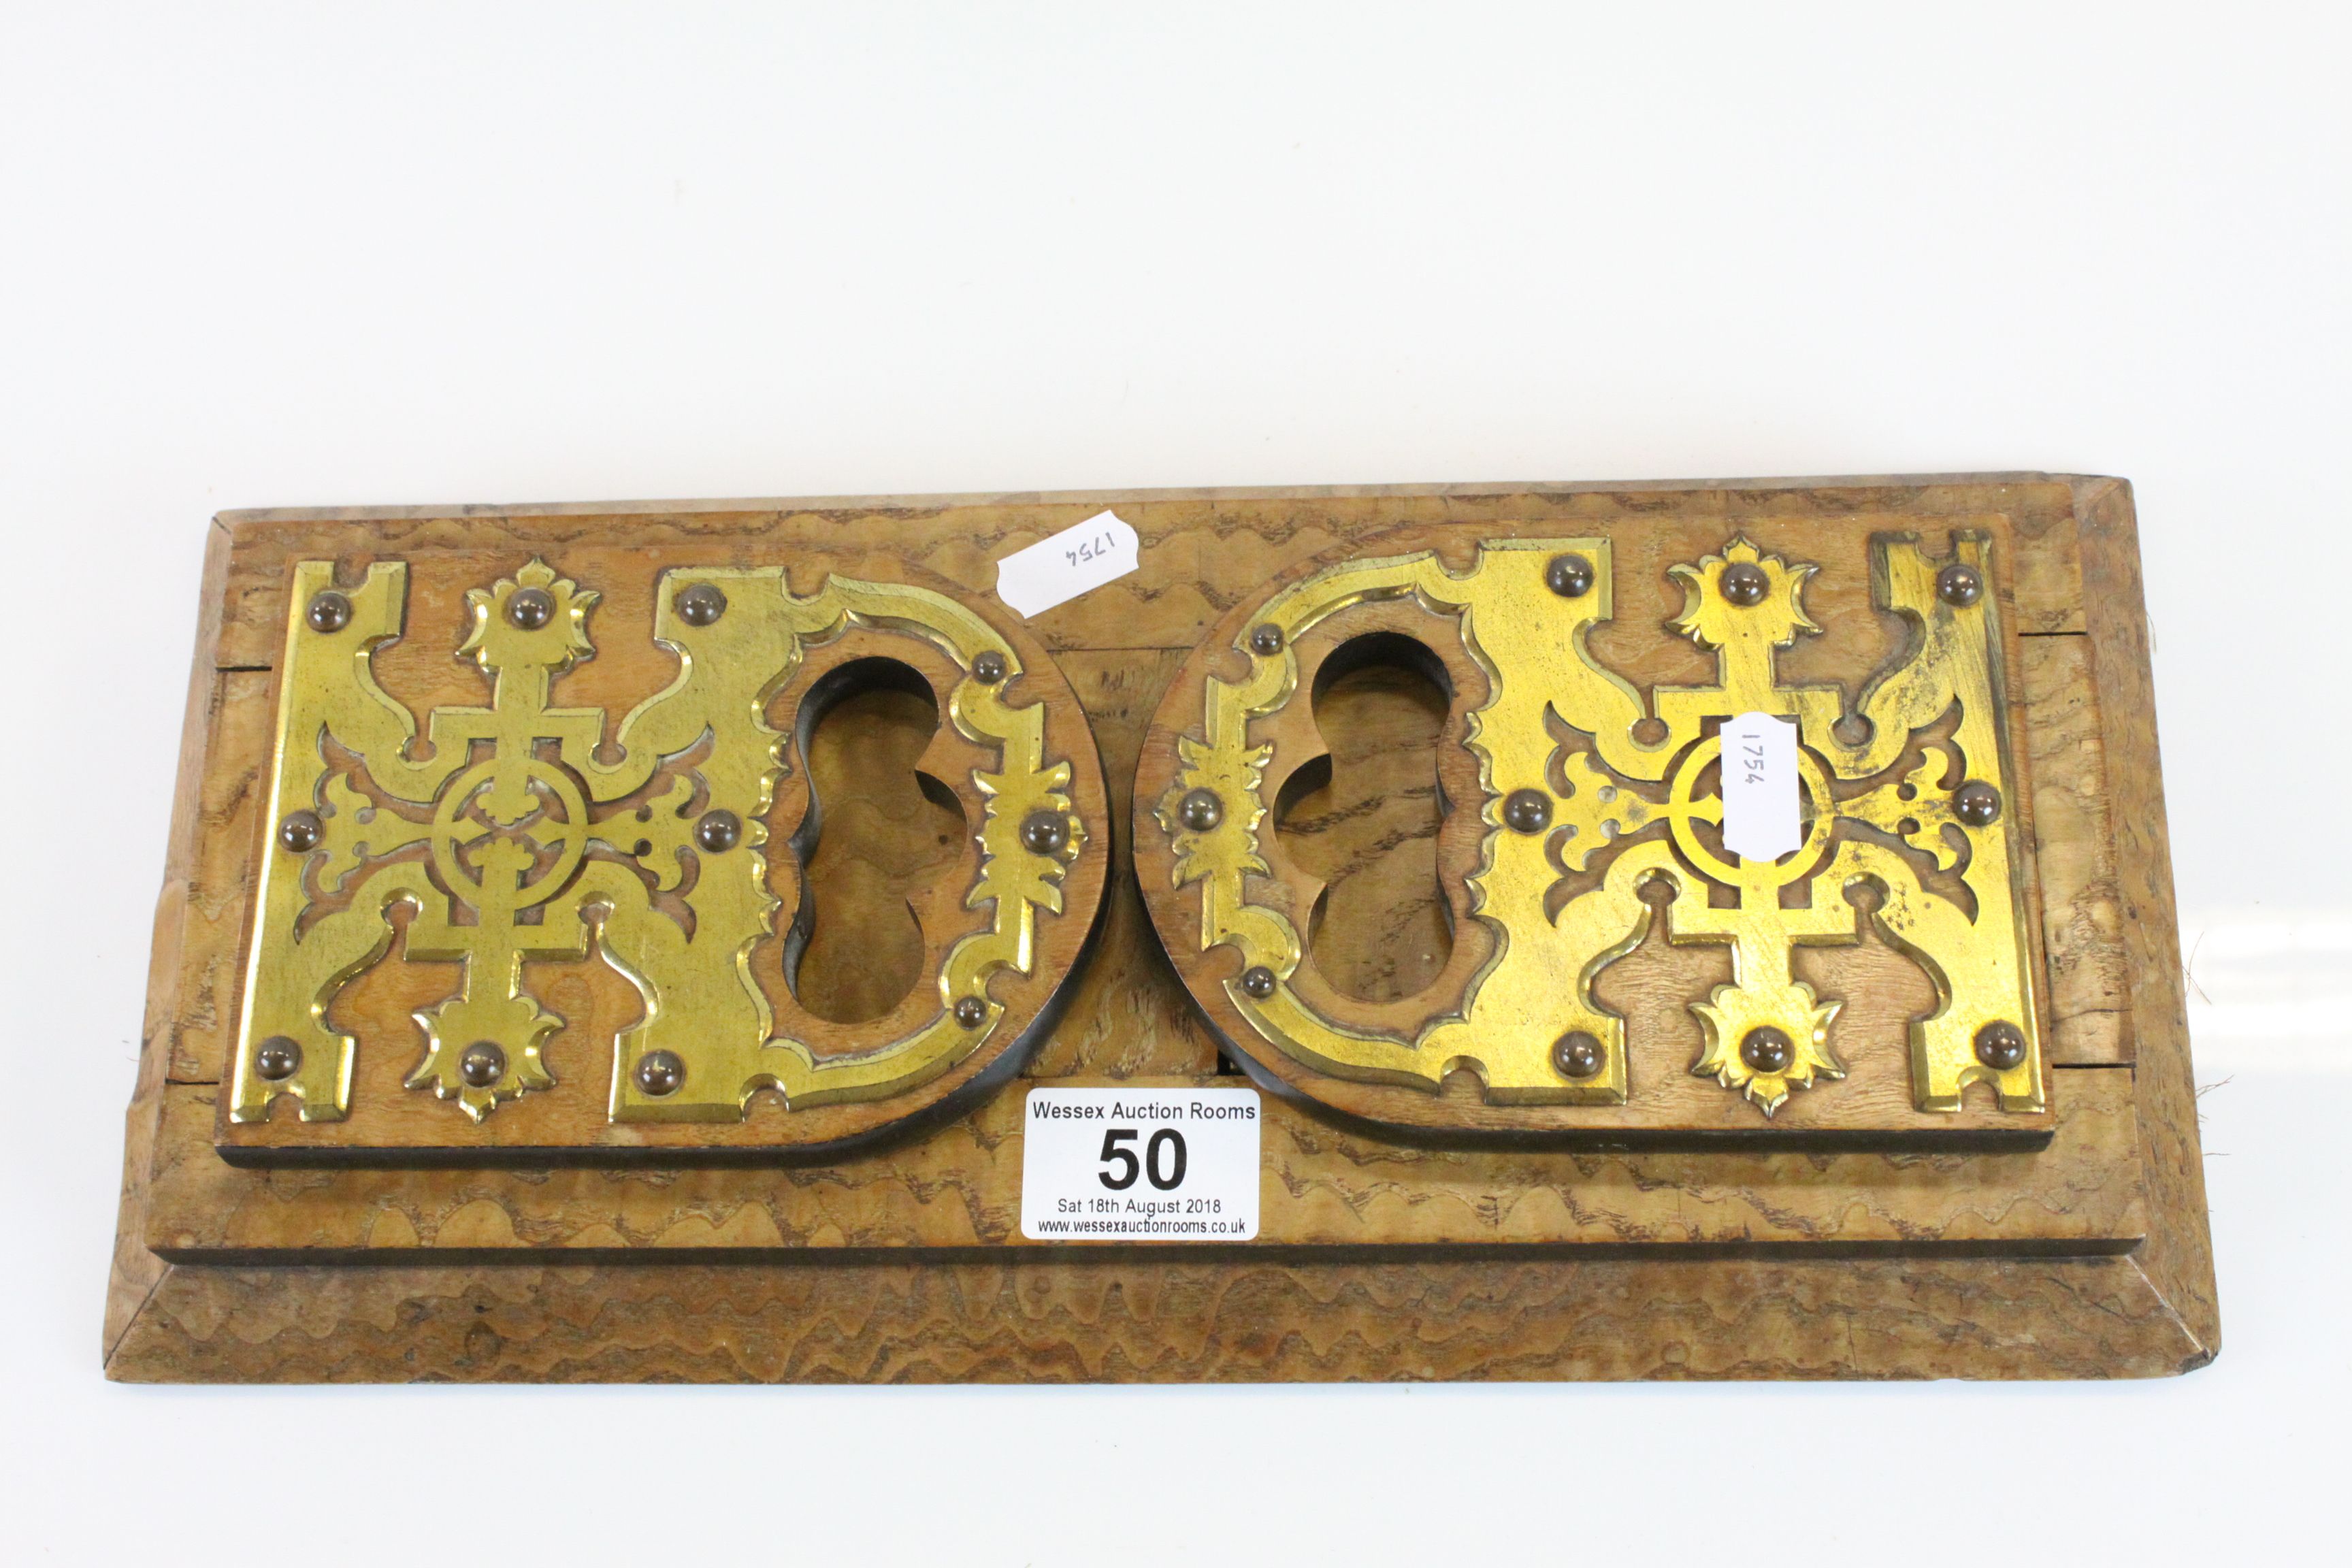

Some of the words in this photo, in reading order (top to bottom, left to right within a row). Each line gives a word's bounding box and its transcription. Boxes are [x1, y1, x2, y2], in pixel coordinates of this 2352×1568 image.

[1066, 532, 1115, 566] 1754
[1742, 734, 1765, 784] 1754
[1032, 1101, 1105, 1120] Wessex
[1111, 1101, 1183, 1120] Auction
[1190, 1102, 1256, 1120] Rooms
[1098, 1128, 1188, 1191] 50
[1058, 1198, 1081, 1213] Sat
[1088, 1198, 1120, 1213] 18th
[1125, 1199, 1180, 1218] August
[1186, 1198, 1221, 1213] 2018
[1039, 1218, 1245, 1233] www.wessexauctionrooms.co.uk
